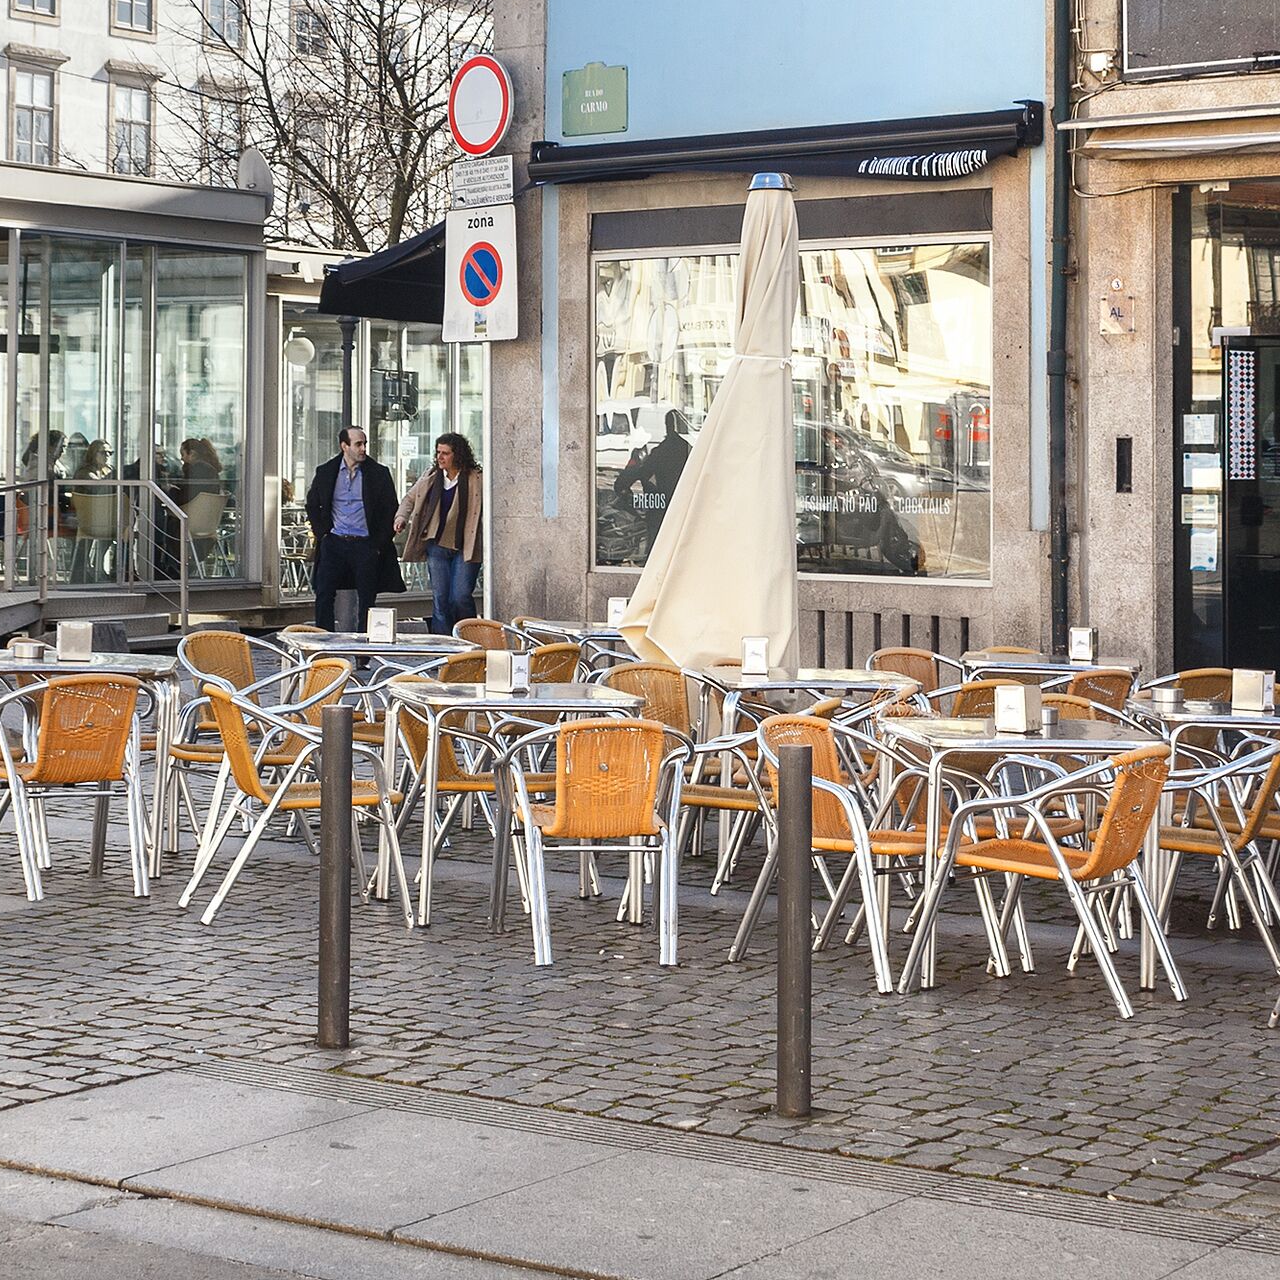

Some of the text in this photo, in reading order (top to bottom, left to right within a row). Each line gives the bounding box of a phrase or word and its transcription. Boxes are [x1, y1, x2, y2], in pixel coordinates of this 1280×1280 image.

[584, 88, 604, 98] RUA DO
[580, 100, 608, 114] CARMO
[467, 215, 494, 229] zona
[632, 492, 666, 510] PREGOS
[842, 495, 856, 513] NO
[858, 492, 878, 513] PÃO
[898, 496, 951, 515] COCKTAILS
